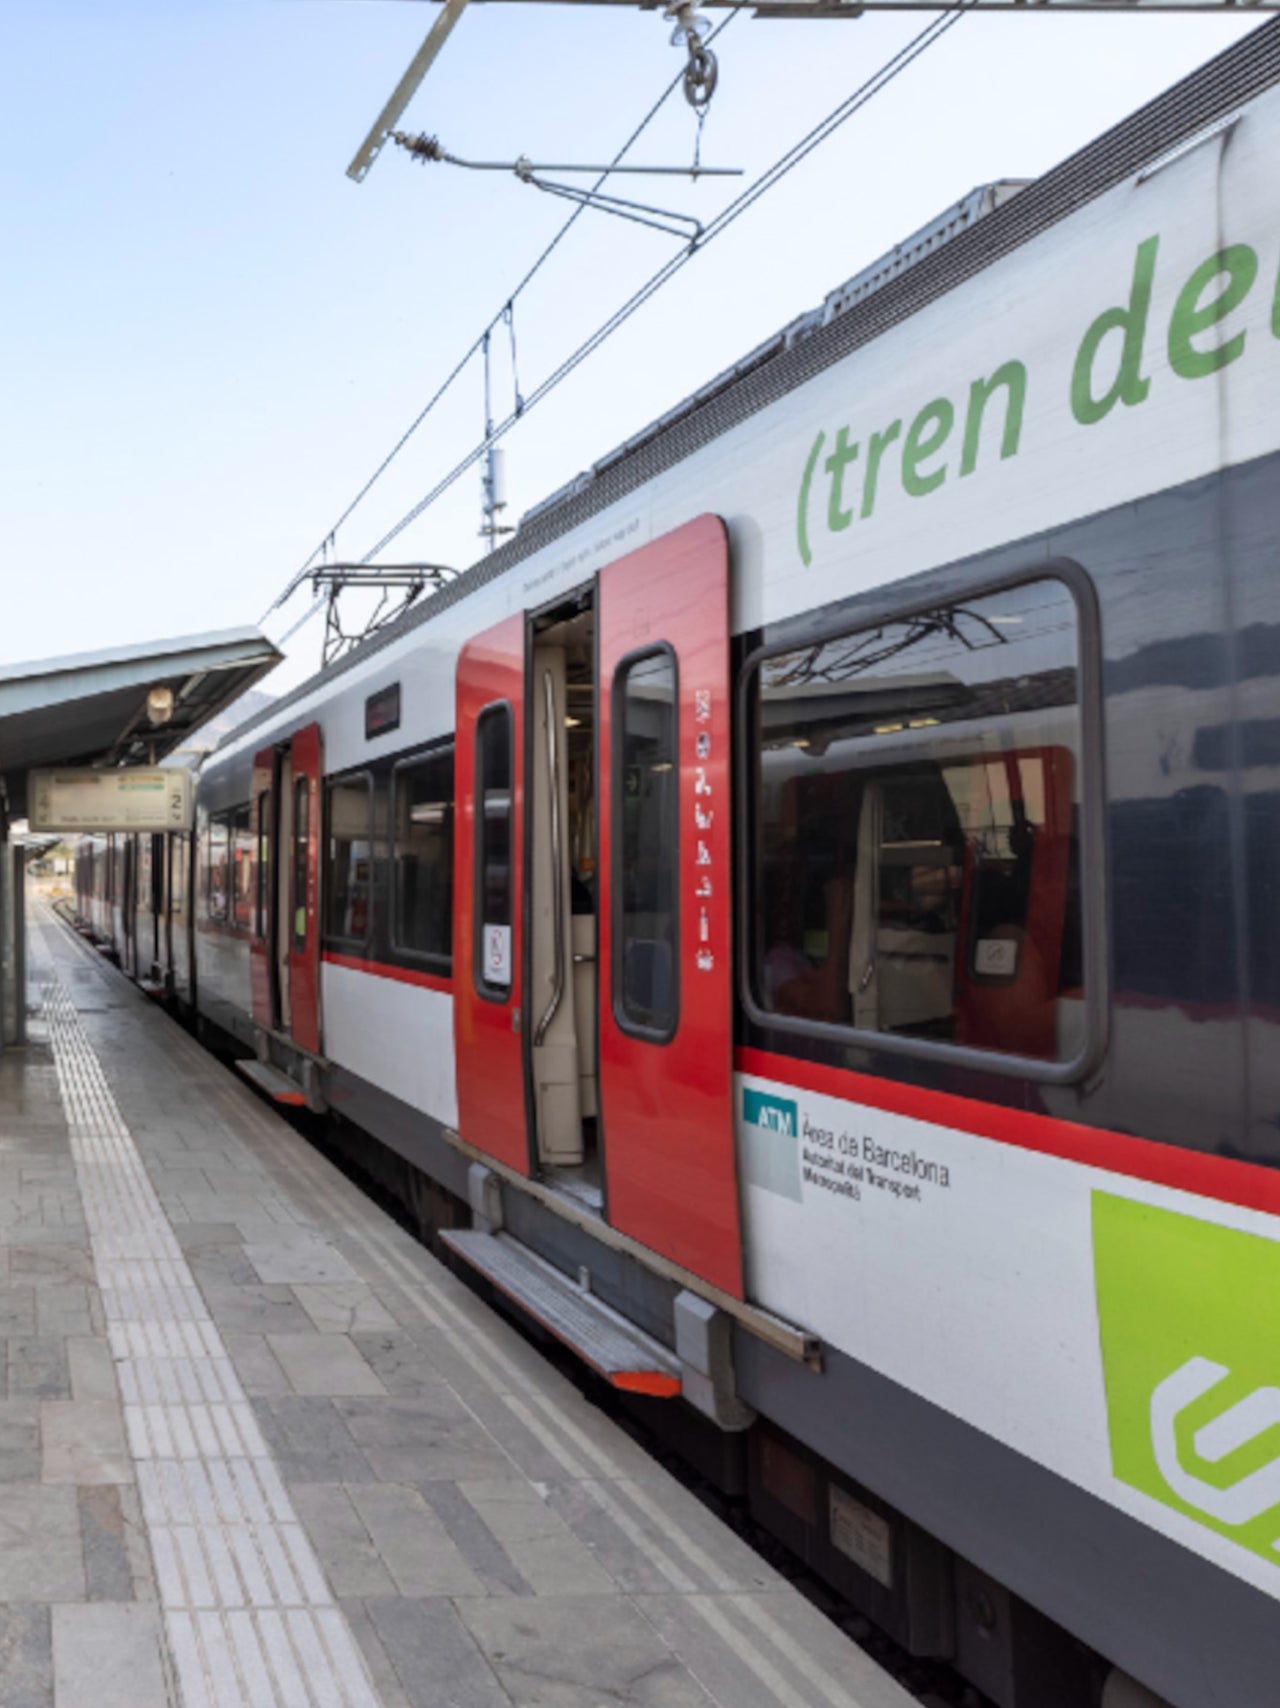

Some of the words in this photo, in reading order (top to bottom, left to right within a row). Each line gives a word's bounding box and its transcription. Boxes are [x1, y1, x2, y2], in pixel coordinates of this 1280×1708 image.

[797, 359, 1027, 568] (tren
[1070, 232, 1280, 425] de
[171, 794, 182, 810] 2
[757, 1106, 793, 1136] ATM
[838, 1131, 859, 1158] de
[863, 1135, 950, 1188] Barcelona
